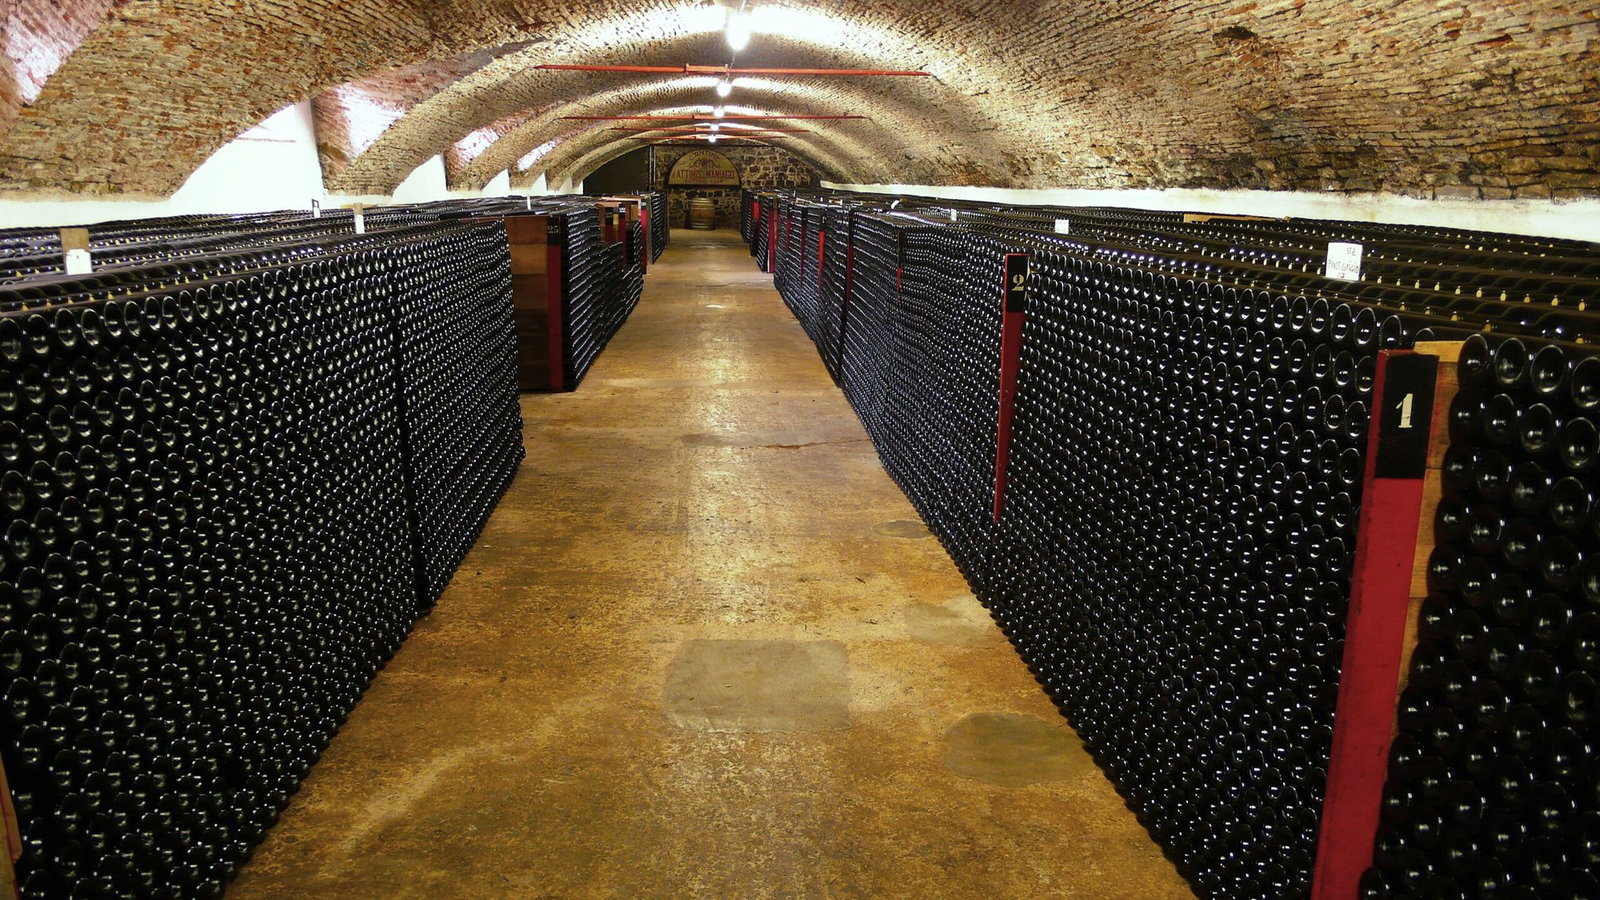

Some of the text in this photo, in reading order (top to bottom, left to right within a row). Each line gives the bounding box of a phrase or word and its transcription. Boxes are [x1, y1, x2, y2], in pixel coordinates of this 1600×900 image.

[547, 225, 559, 234] 25
[1011, 274, 1025, 291] 2
[1395, 393, 1414, 428] 1
